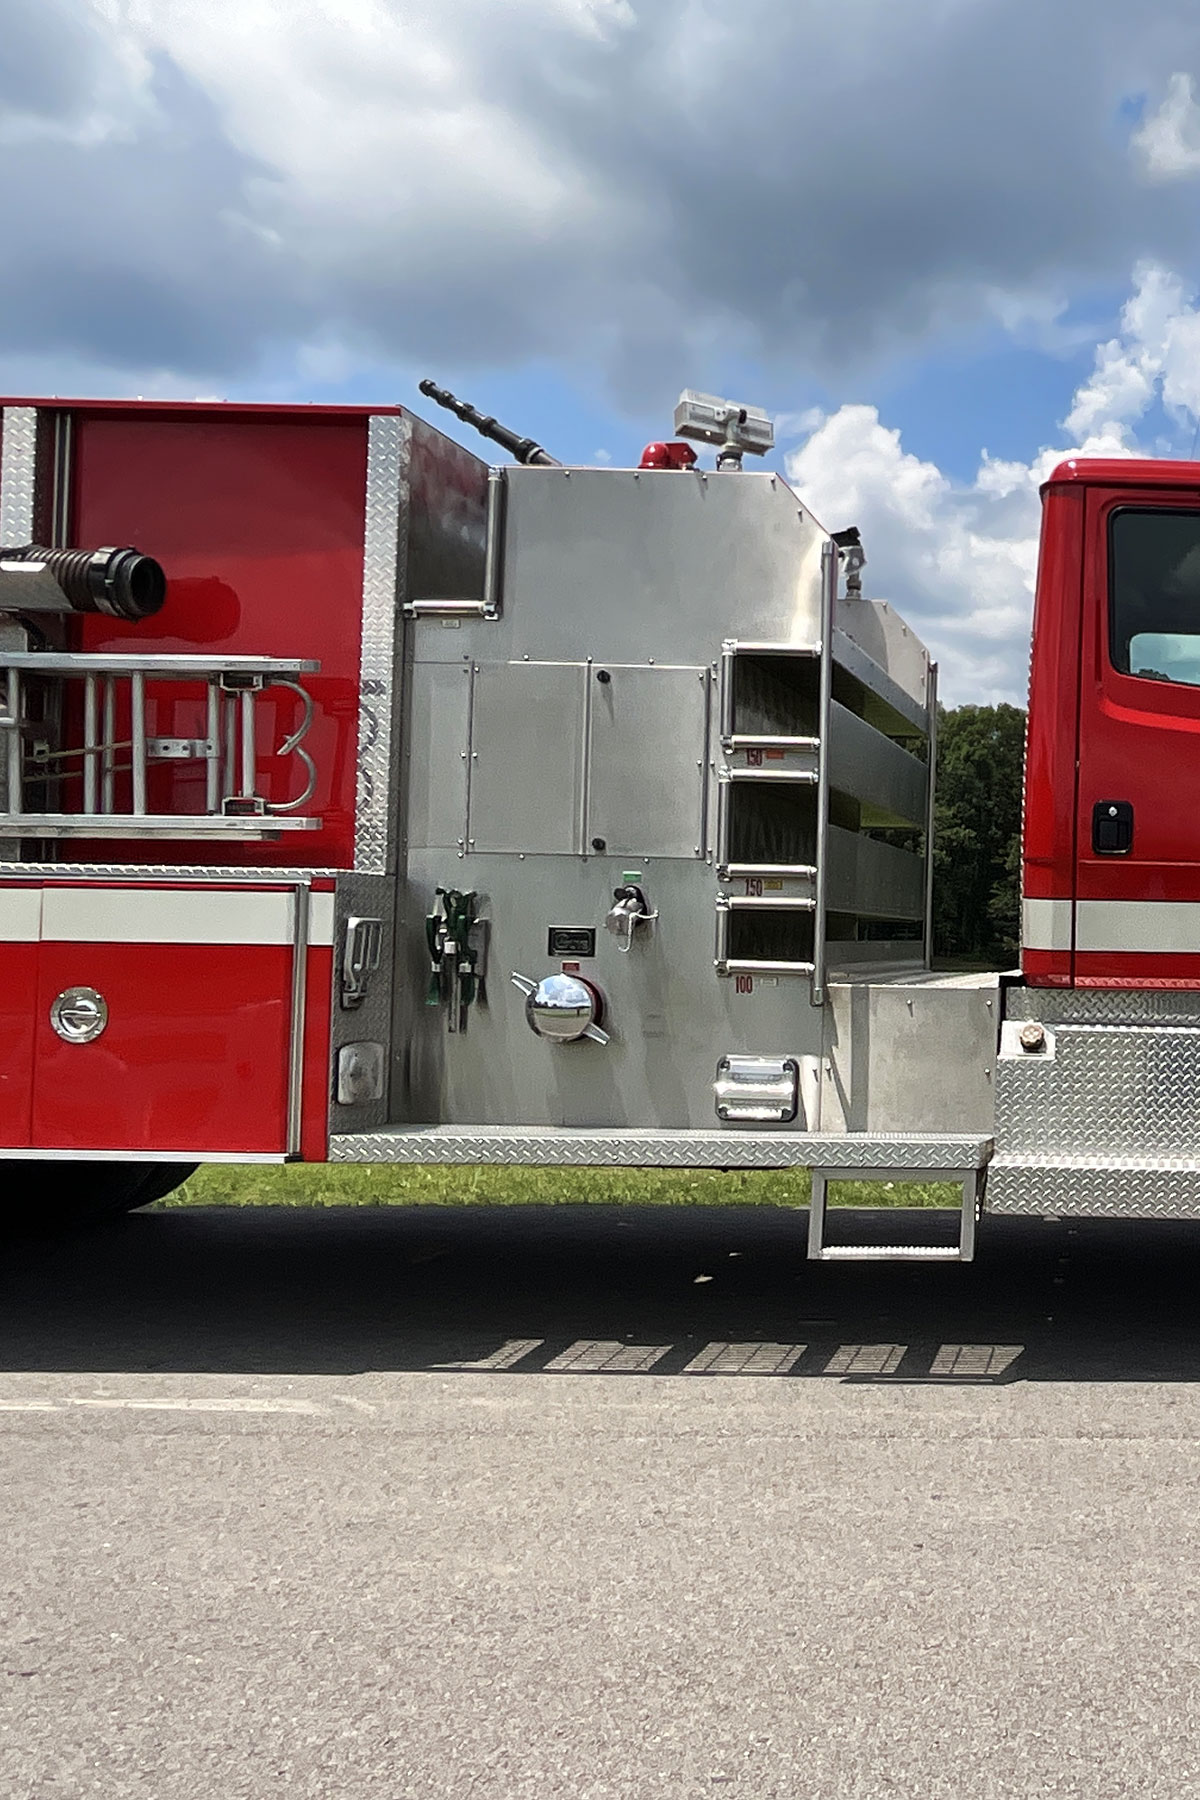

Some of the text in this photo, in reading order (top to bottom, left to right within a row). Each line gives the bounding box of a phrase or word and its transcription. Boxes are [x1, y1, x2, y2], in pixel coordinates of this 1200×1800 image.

[747, 748, 763, 766] 150
[745, 878, 763, 896] 150
[736, 975, 752, 994] 100
